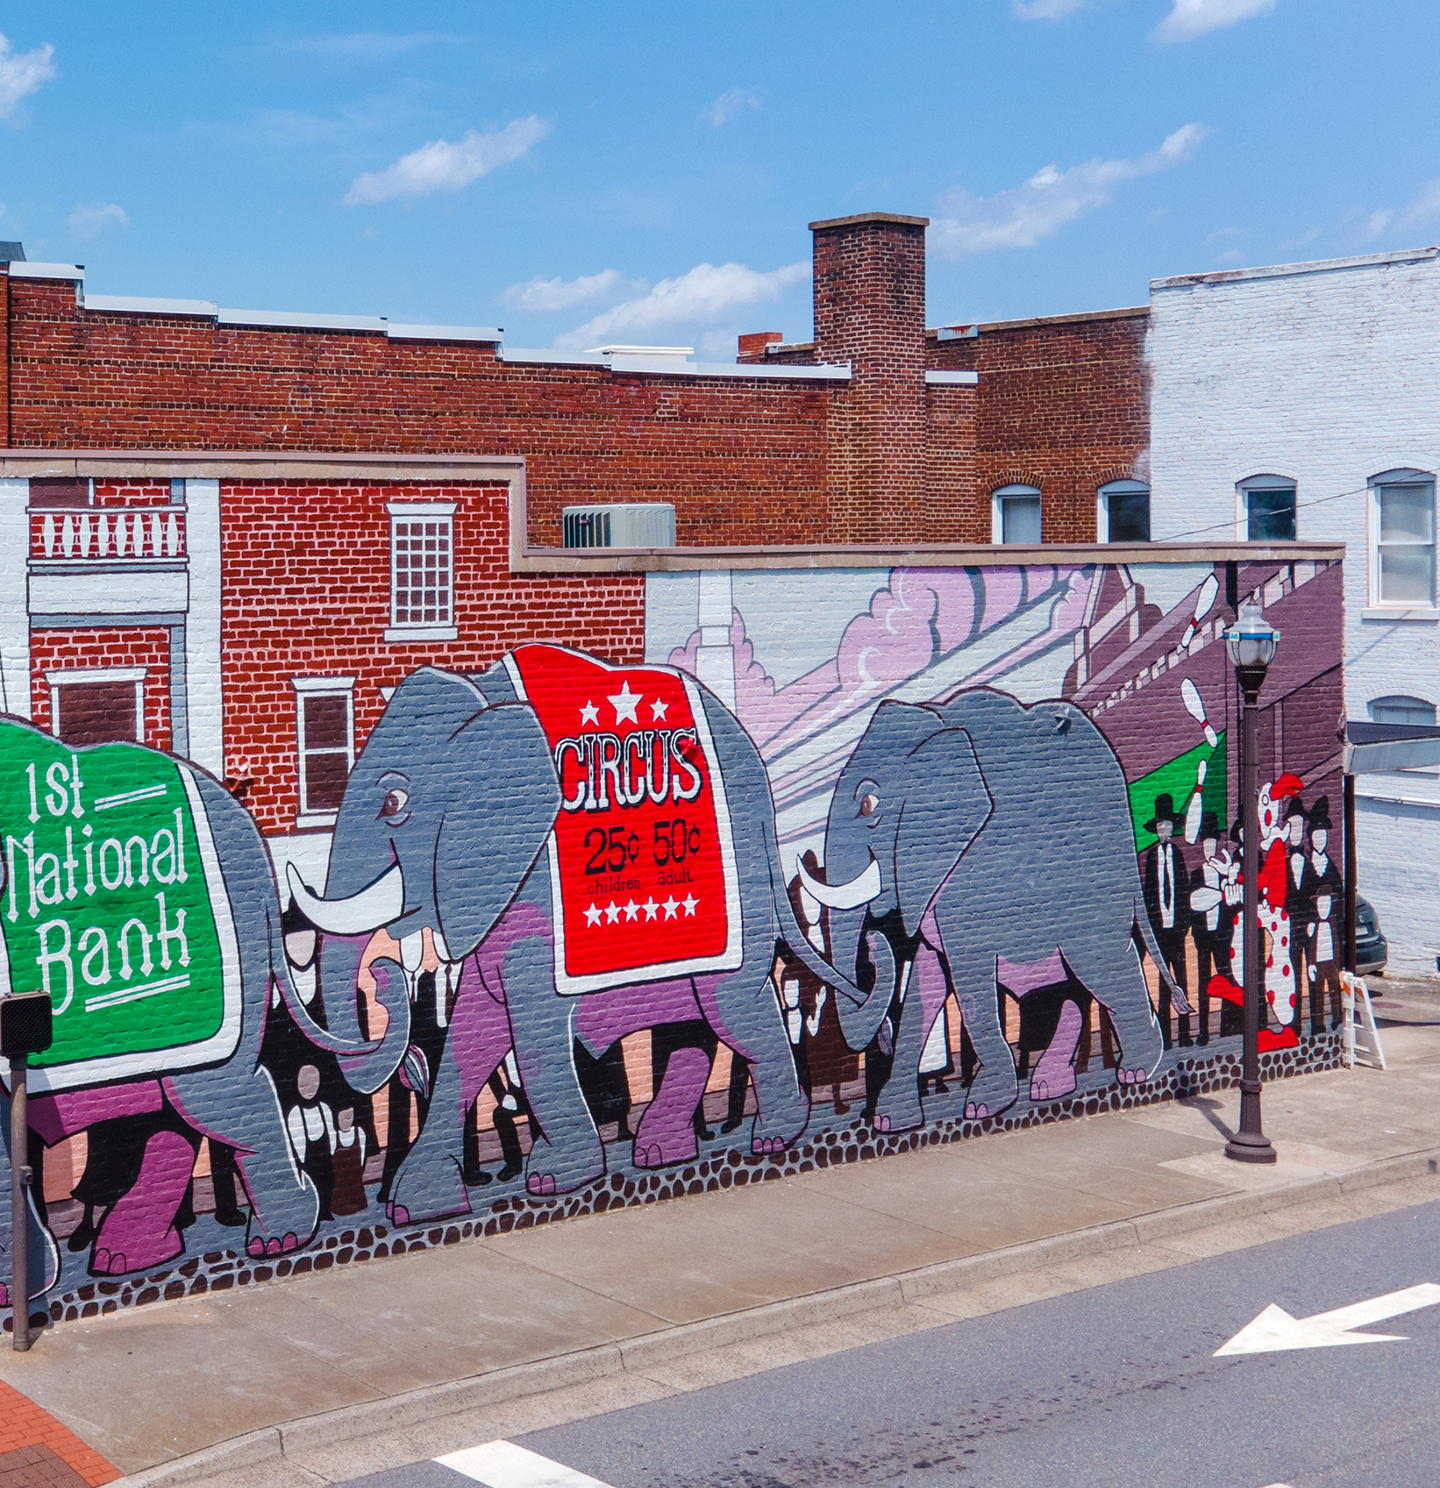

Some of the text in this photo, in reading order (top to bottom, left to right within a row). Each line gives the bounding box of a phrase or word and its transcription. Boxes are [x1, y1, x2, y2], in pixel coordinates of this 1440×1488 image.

[25, 754, 84, 824] 1st
[554, 728, 704, 814] CIRCUS
[6, 806, 188, 923] National
[584, 817, 701, 876] 25¢ 50¢
[587, 868, 694, 896] children adult
[35, 891, 192, 1016] Bank
